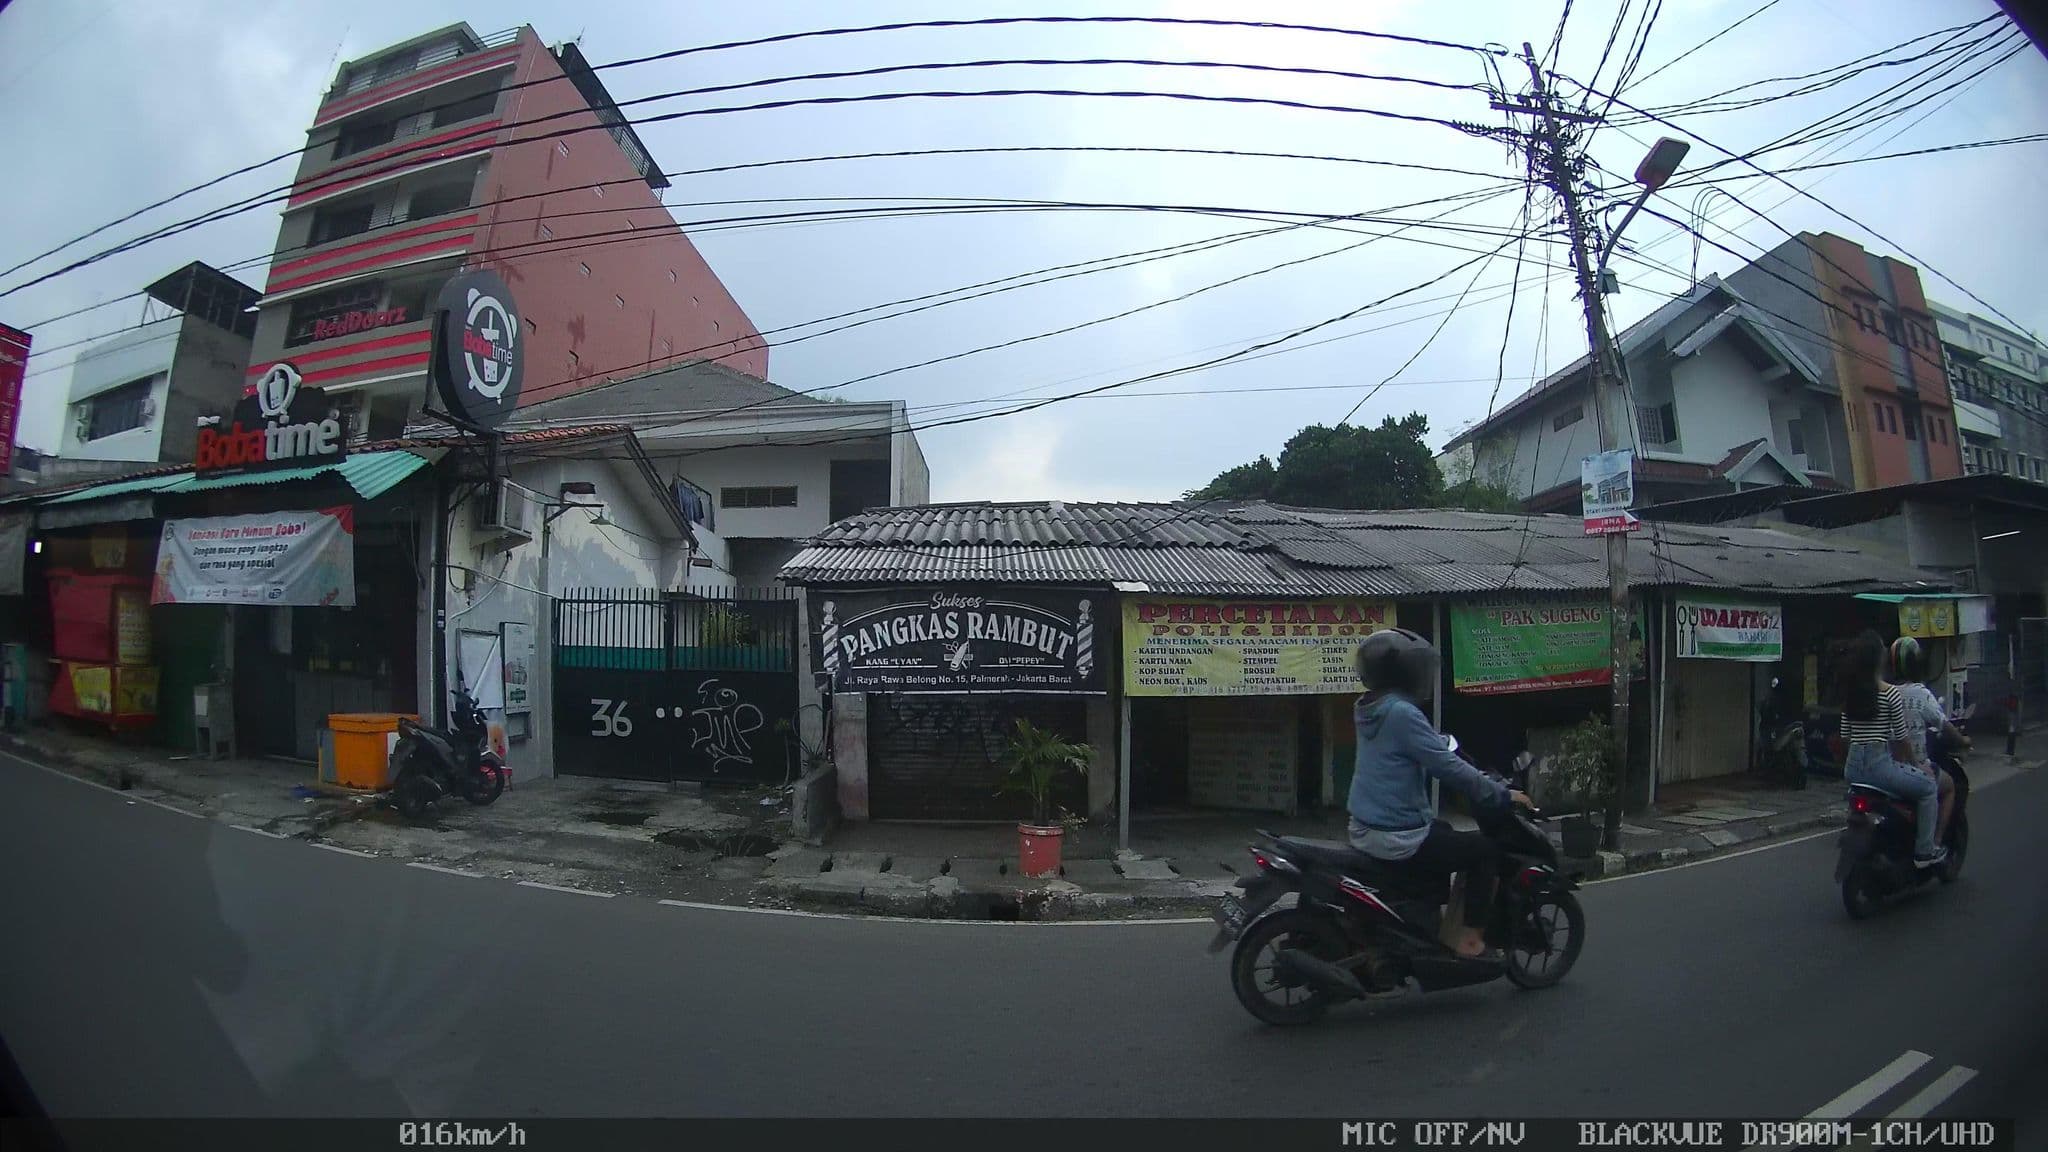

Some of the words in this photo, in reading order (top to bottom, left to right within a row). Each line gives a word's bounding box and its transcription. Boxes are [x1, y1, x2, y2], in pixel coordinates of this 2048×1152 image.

[313, 306, 408, 341] RedDoorz
[930, 591, 985, 610] Sukses
[1137, 603, 1385, 625] PERCETAKAN
[1539, 607, 1601, 625] SUGENG
[1152, 624, 1231, 636] POLI
[1241, 625, 1262, 637] &
[1271, 625, 1374, 637] EMBOS
[840, 611, 959, 663] PANGKAS
[966, 611, 1075, 660] RAMBUT
[1146, 637, 1209, 646] MENERIMA
[1211, 637, 1256, 646] SEGALA
[1258, 637, 1298, 646] MACAM
[1138, 647, 1167, 655] KARTU
[1168, 647, 1214, 655] UNDANGAN
[1242, 647, 1280, 655] SPANDUK
[1321, 646, 1348, 655] STIKER
[1138, 657, 1167, 665] KARTU
[1169, 657, 1193, 665] NAMA
[1242, 657, 1278, 665] STEMPEL
[1138, 667, 1157, 676] KOP
[1158, 667, 1185, 676] SURAT
[1243, 667, 1276, 675] BROSUR
[1322, 666, 1347, 675] SURAT
[857, 676, 879, 686] Raya
[880, 675, 904, 685] Rawa
[906, 675, 937, 686] Belong
[938, 675, 954, 684] No.
[1016, 674, 1048, 684] Jakarta
[1049, 674, 1072, 684] Barat
[1138, 677, 1163, 686] NEON
[590, 698, 633, 737] 36
